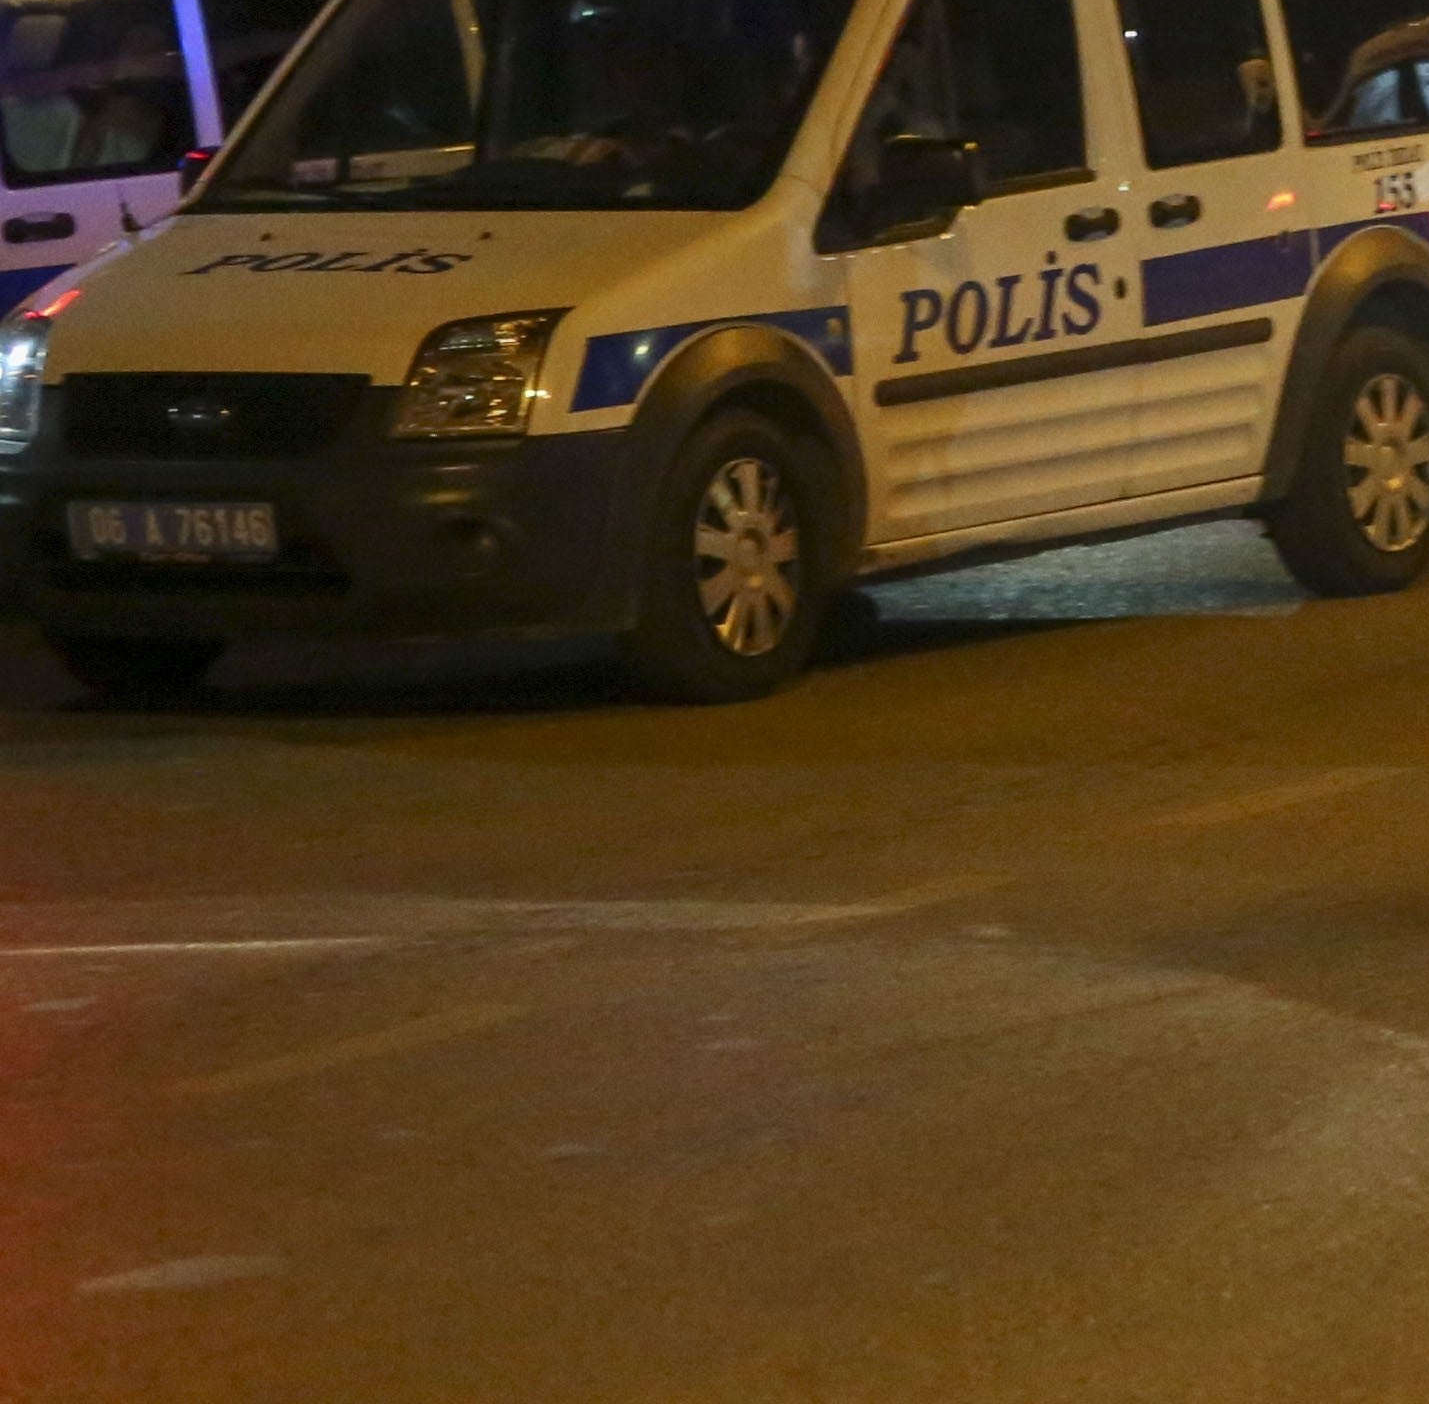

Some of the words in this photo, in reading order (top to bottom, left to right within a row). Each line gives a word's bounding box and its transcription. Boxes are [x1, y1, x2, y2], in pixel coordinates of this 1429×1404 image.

[178, 248, 473, 275] POLİS
[892, 251, 1102, 364] POLİS
[88, 507, 127, 545] 06
[143, 508, 165, 545] A
[174, 507, 273, 546] 76146
